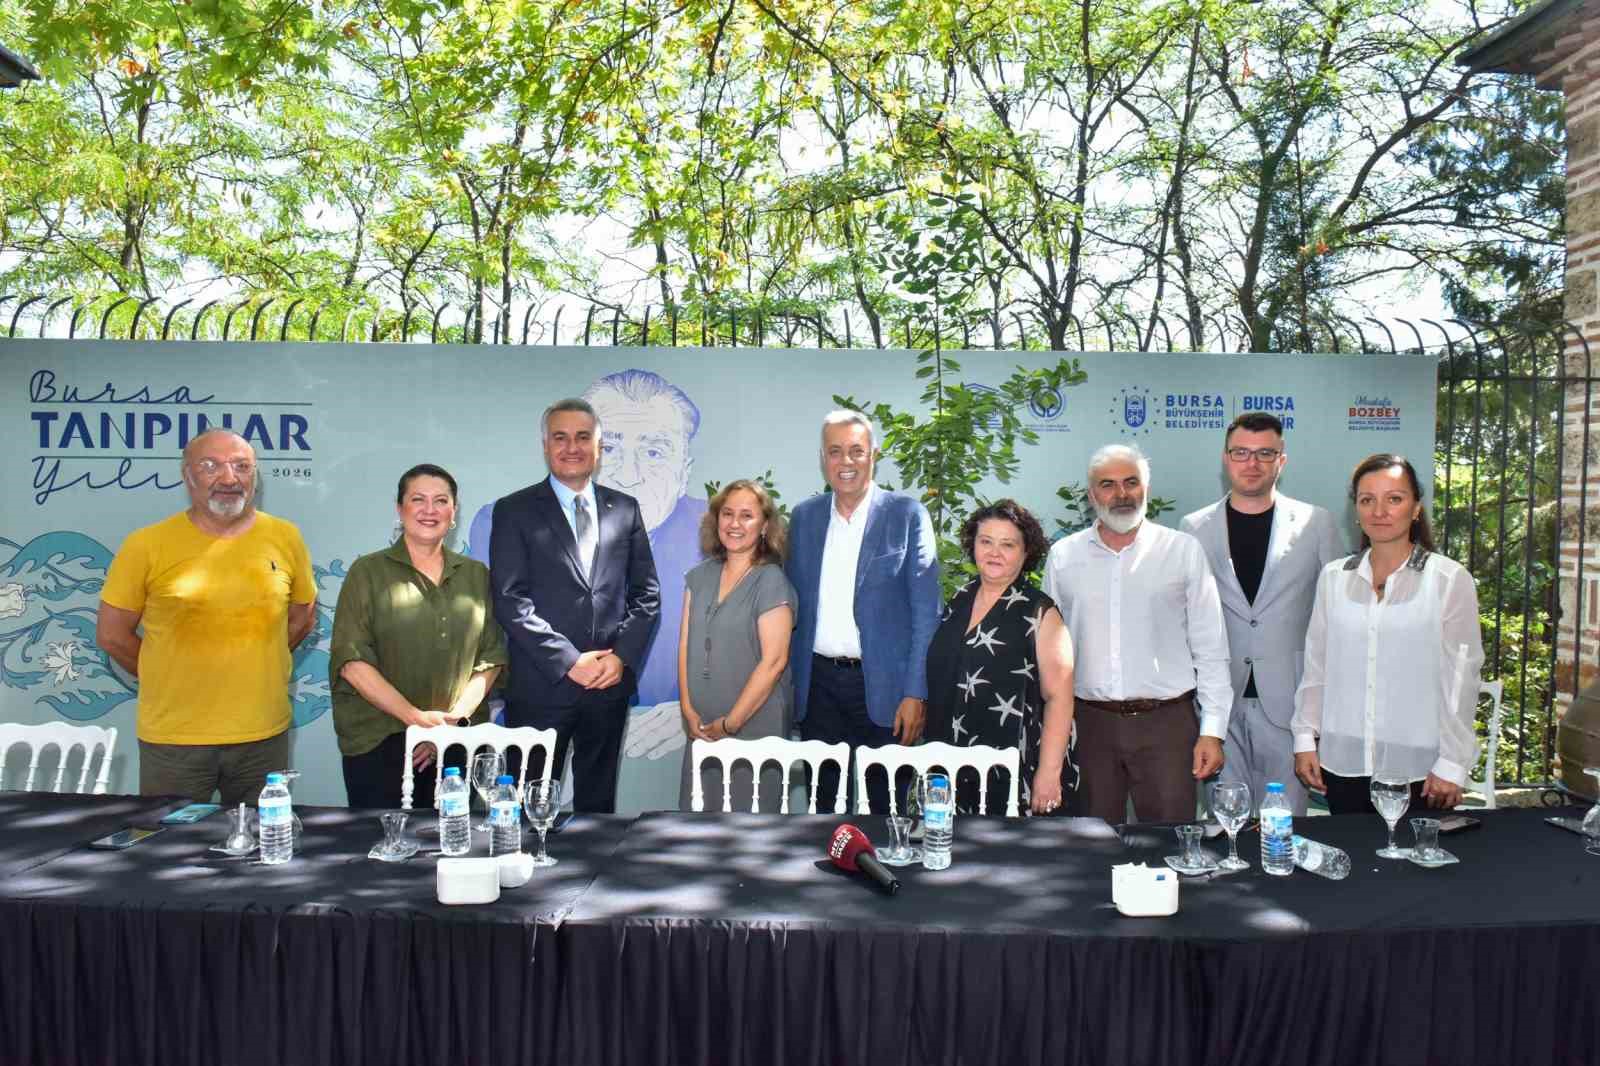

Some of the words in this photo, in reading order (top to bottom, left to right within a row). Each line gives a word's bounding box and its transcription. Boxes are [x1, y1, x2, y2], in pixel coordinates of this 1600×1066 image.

[29, 370, 215, 404] Bursa
[1166, 395, 1224, 407] BURSA
[1243, 396, 1295, 410] BURSA
[1348, 407, 1401, 417] BOZBEY
[1166, 418, 1224, 428] BELEDİYESİ
[272, 468, 312, 478] 2026
